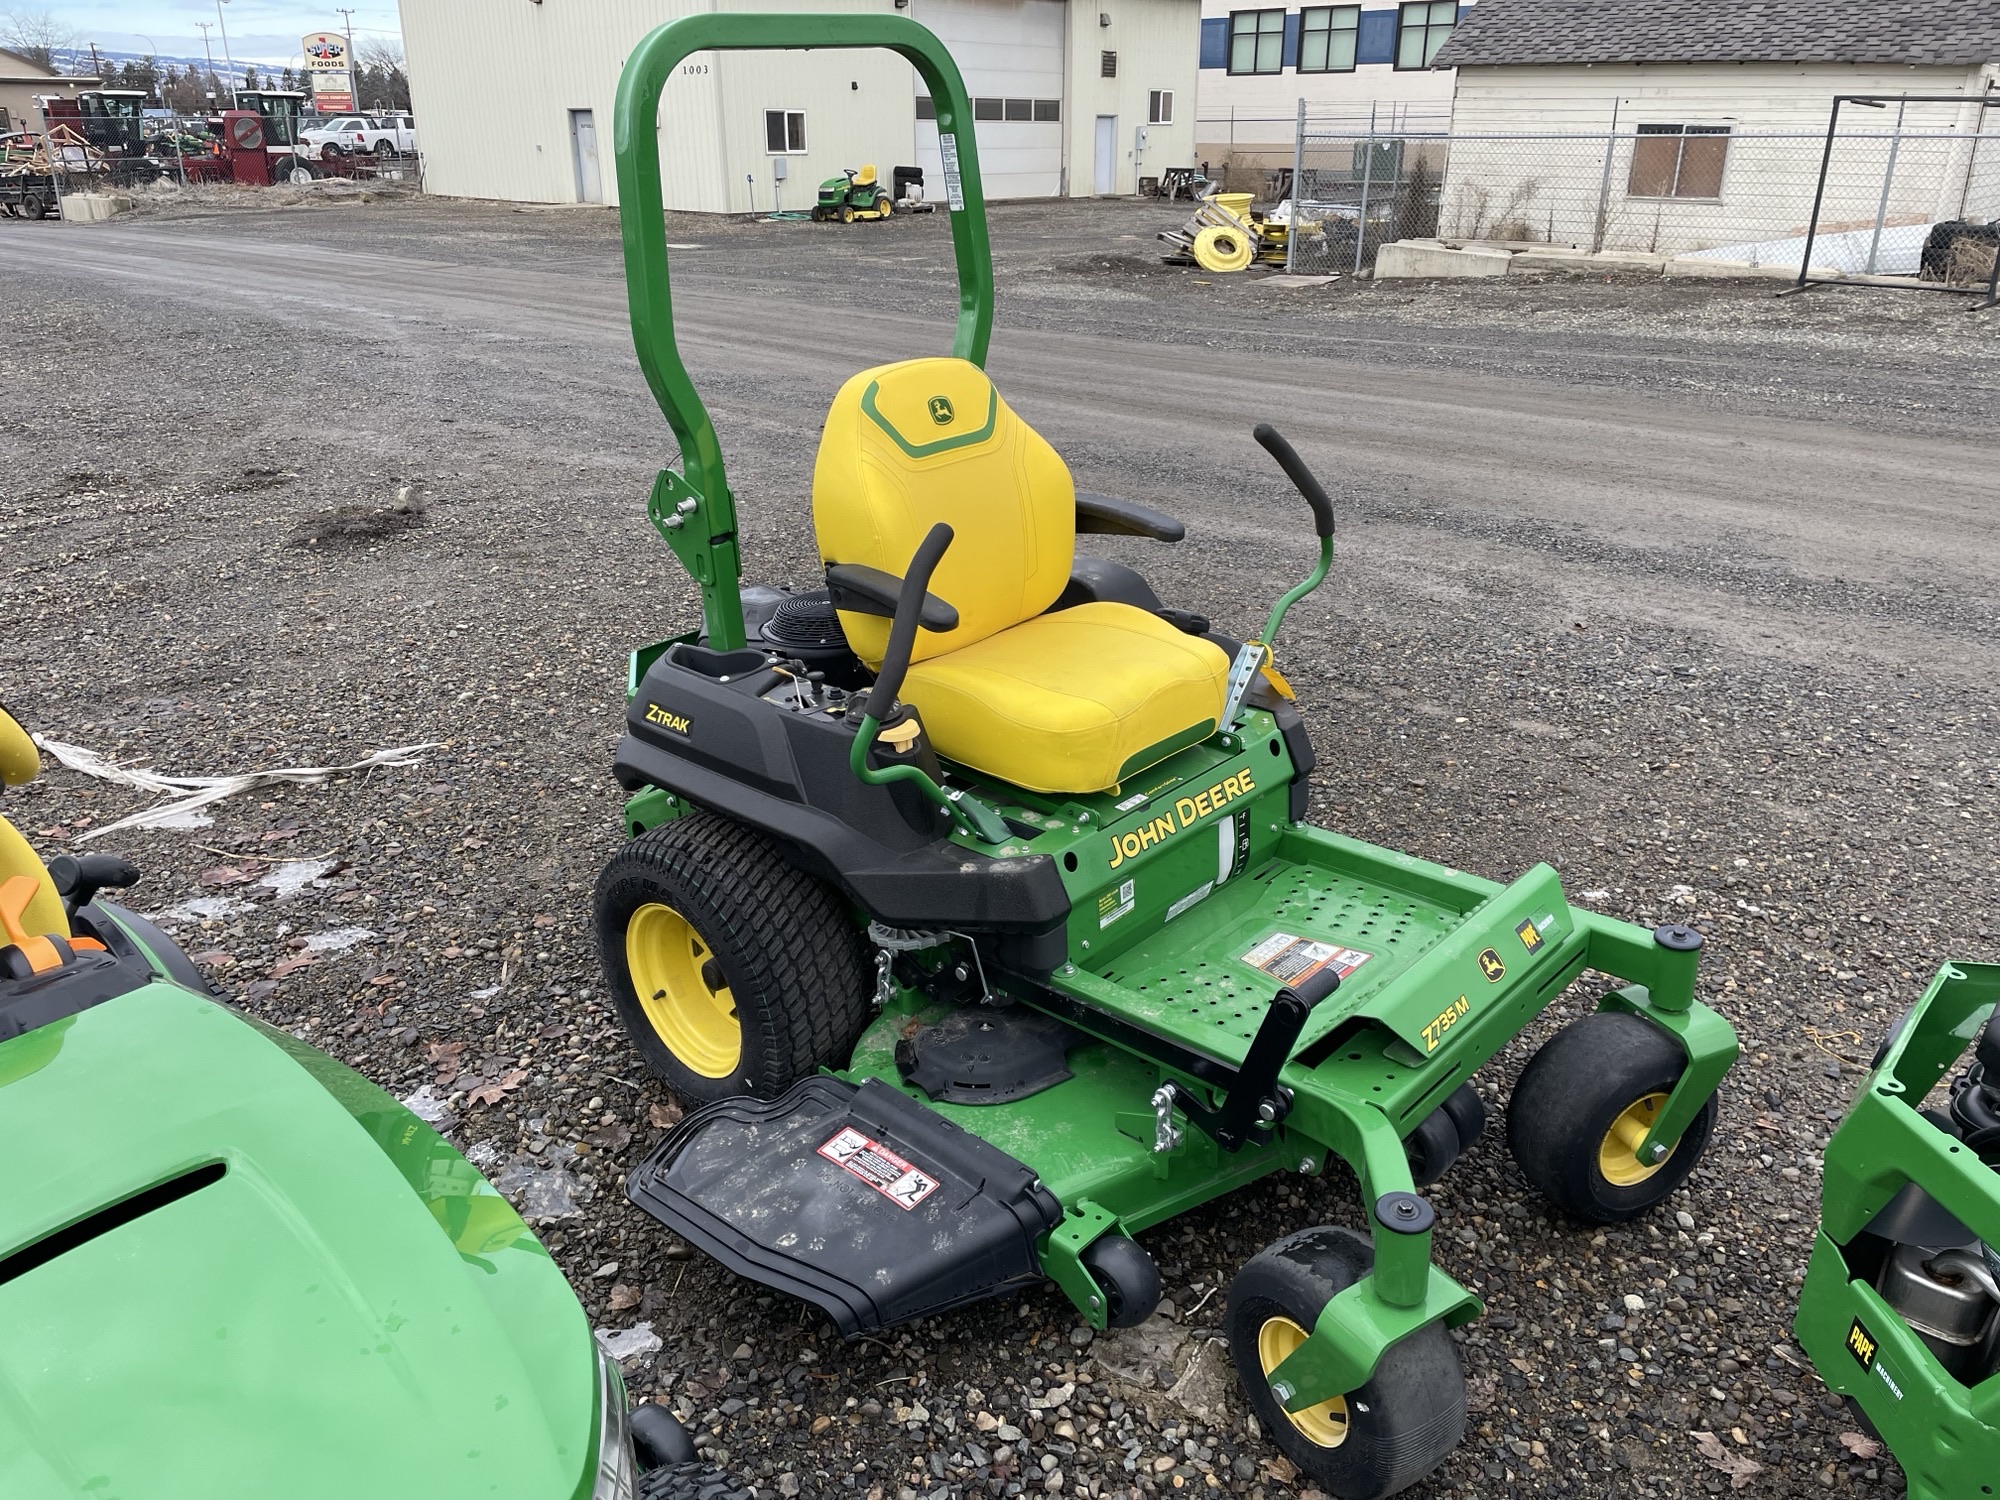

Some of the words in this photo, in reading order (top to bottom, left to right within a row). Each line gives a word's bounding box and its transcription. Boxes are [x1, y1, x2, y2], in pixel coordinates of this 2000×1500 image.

[310, 42, 341, 56] SUPER
[311, 60, 345, 68] FOODS
[682, 64, 709, 75] 1003
[645, 703, 691, 734] ZTRAK
[1109, 811, 1177, 870] JOHN
[1175, 767, 1257, 829] DEERE
[878, 1149, 909, 1169] DANGER
[1875, 1361, 1905, 1401] MACHINERY
